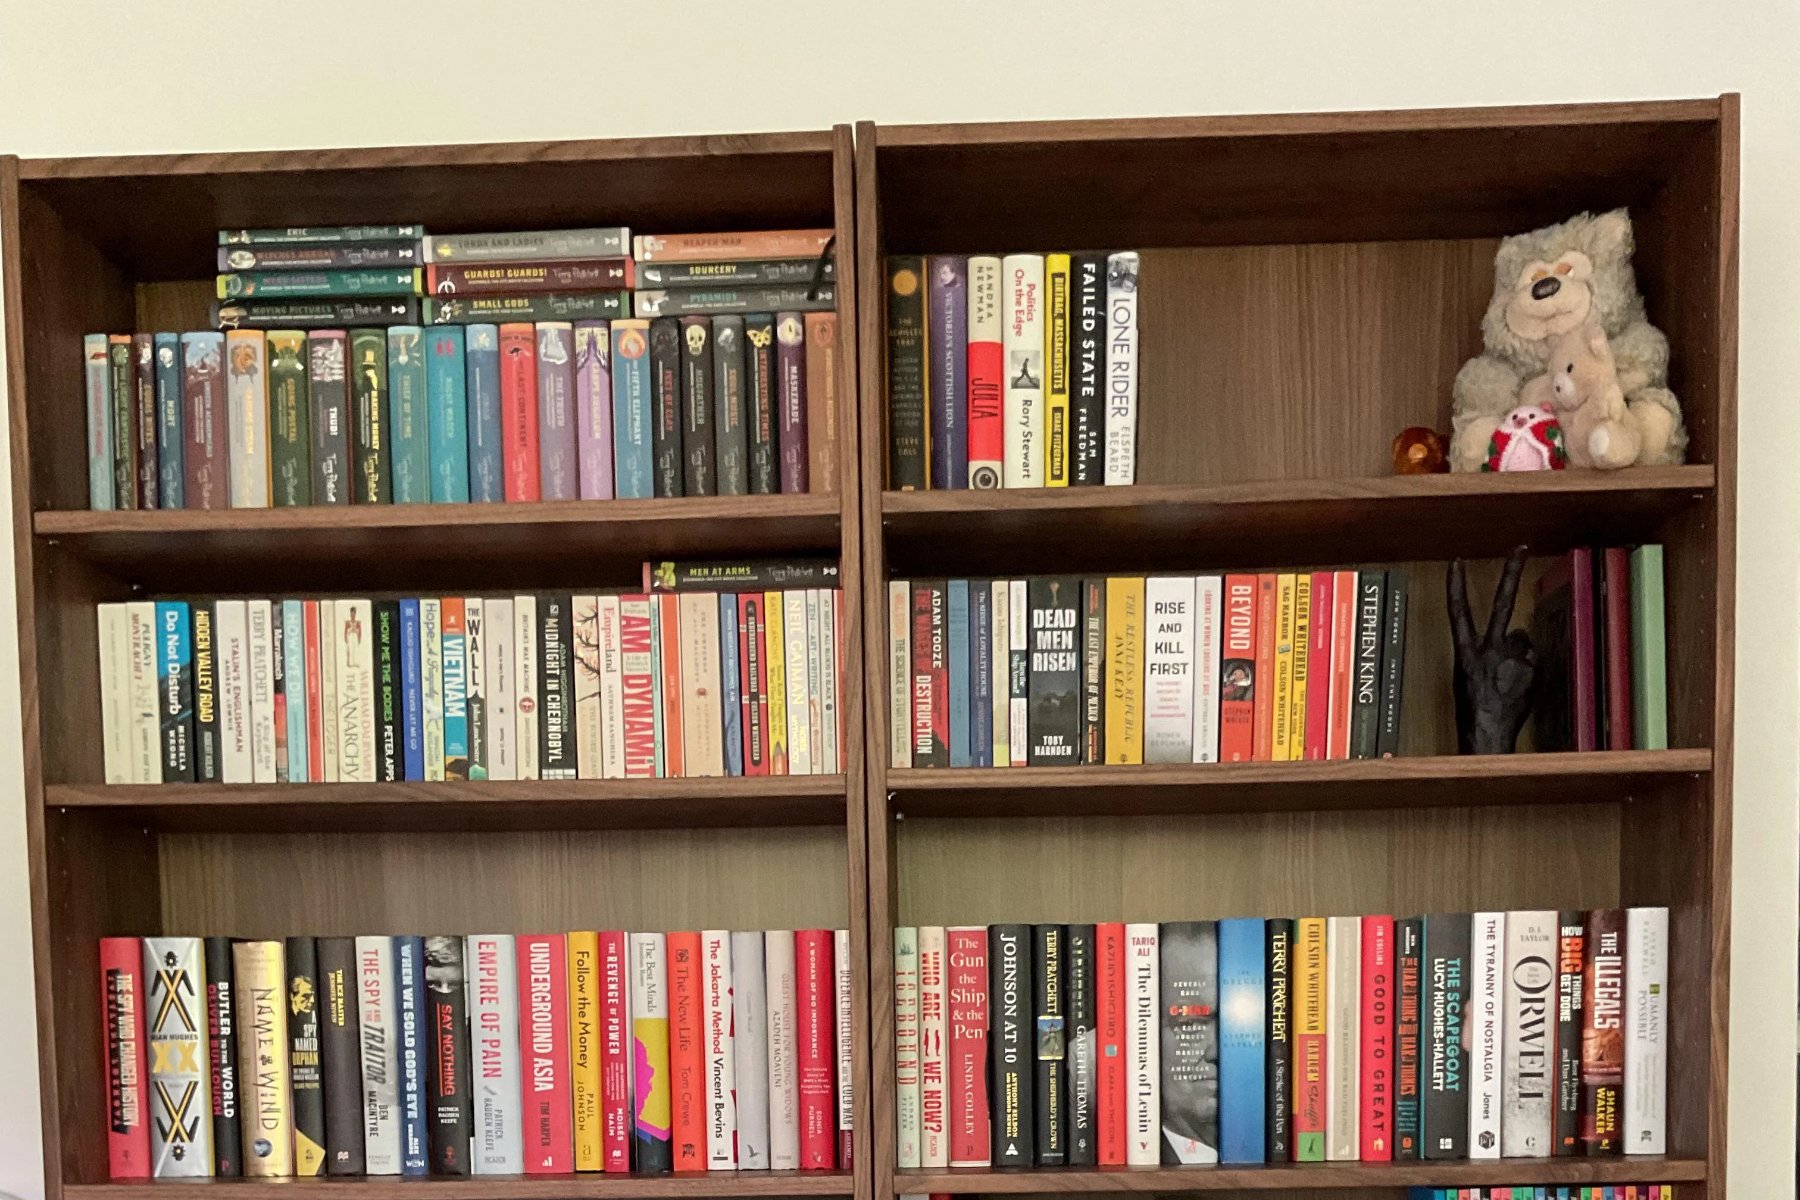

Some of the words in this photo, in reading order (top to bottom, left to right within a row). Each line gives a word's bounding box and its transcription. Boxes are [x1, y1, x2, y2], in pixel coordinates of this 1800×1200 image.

[287, 228, 308, 236] ERIC
[464, 269, 504, 279] GUARDS!
[507, 268, 547, 278] GUARDS!
[689, 266, 737, 275] SOURCERY
[473, 299, 501, 308] SMALL
[505, 298, 529, 308] GODS
[1026, 283, 1036, 322] Politics
[1082, 263, 1096, 331] FAILED
[1113, 298, 1130, 354] LONE
[1081, 340, 1094, 397] STATE
[789, 366, 799, 424] MASKERADE
[1111, 361, 1129, 418] RIDER
[329, 407, 338, 436] THUD!
[1019, 399, 1032, 426] Rory
[1022, 431, 1032, 479] Stewart
[1078, 408, 1086, 480] FREEDMAN
[1110, 432, 1118, 473] BEARD
[166, 611, 178, 632] Do
[467, 608, 479, 616] THE
[1033, 609, 1076, 628] DEAD
[1154, 602, 1185, 614] RISE
[1230, 585, 1251, 650] BEYOND
[1362, 585, 1379, 659] STEPHEN
[196, 611, 209, 649] HIDDEN
[622, 616, 650, 652] AM
[1036, 631, 1073, 650] MEN
[1158, 624, 1182, 633] AND
[167, 635, 179, 660] Not
[545, 618, 559, 681] MIDNIGHT
[1033, 652, 1076, 672] RISEN
[1154, 642, 1184, 654] KILL
[197, 651, 212, 696] VALLEY
[443, 638, 465, 717] VIETNAM
[1150, 663, 1189, 675] FIRST
[1359, 662, 1374, 704] KING
[168, 663, 179, 714] Disturb
[200, 699, 214, 722] ROAD
[546, 694, 562, 762] CHERNOBYL
[1277, 693, 1286, 746] WHITEHEAD
[1375, 926, 1383, 937] JIM
[1520, 934, 1549, 942] TAYLOR
[1601, 932, 1617, 954] THE
[363, 949, 378, 973] THE
[709, 940, 720, 959] The
[950, 954, 984, 968] Gun
[1273, 932, 1286, 975] TERRY
[477, 941, 498, 1005] EMPIRE
[711, 962, 722, 1008] Jakarta
[1447, 958, 1460, 988] THE
[364, 977, 380, 1007] SPY
[529, 942, 553, 1054] UNDERGROUND
[950, 989, 986, 1005] Ship
[1594, 956, 1621, 1030] ILLEGALS
[480, 1013, 500, 1032] OF
[1272, 978, 1286, 1042] PRATCHETT
[712, 1010, 723, 1055] Method
[954, 1025, 983, 1039] Pen
[1445, 992, 1460, 1091] SCAPEGOAT
[481, 1039, 502, 1078] PAIN
[534, 1058, 554, 1092] ASIA
